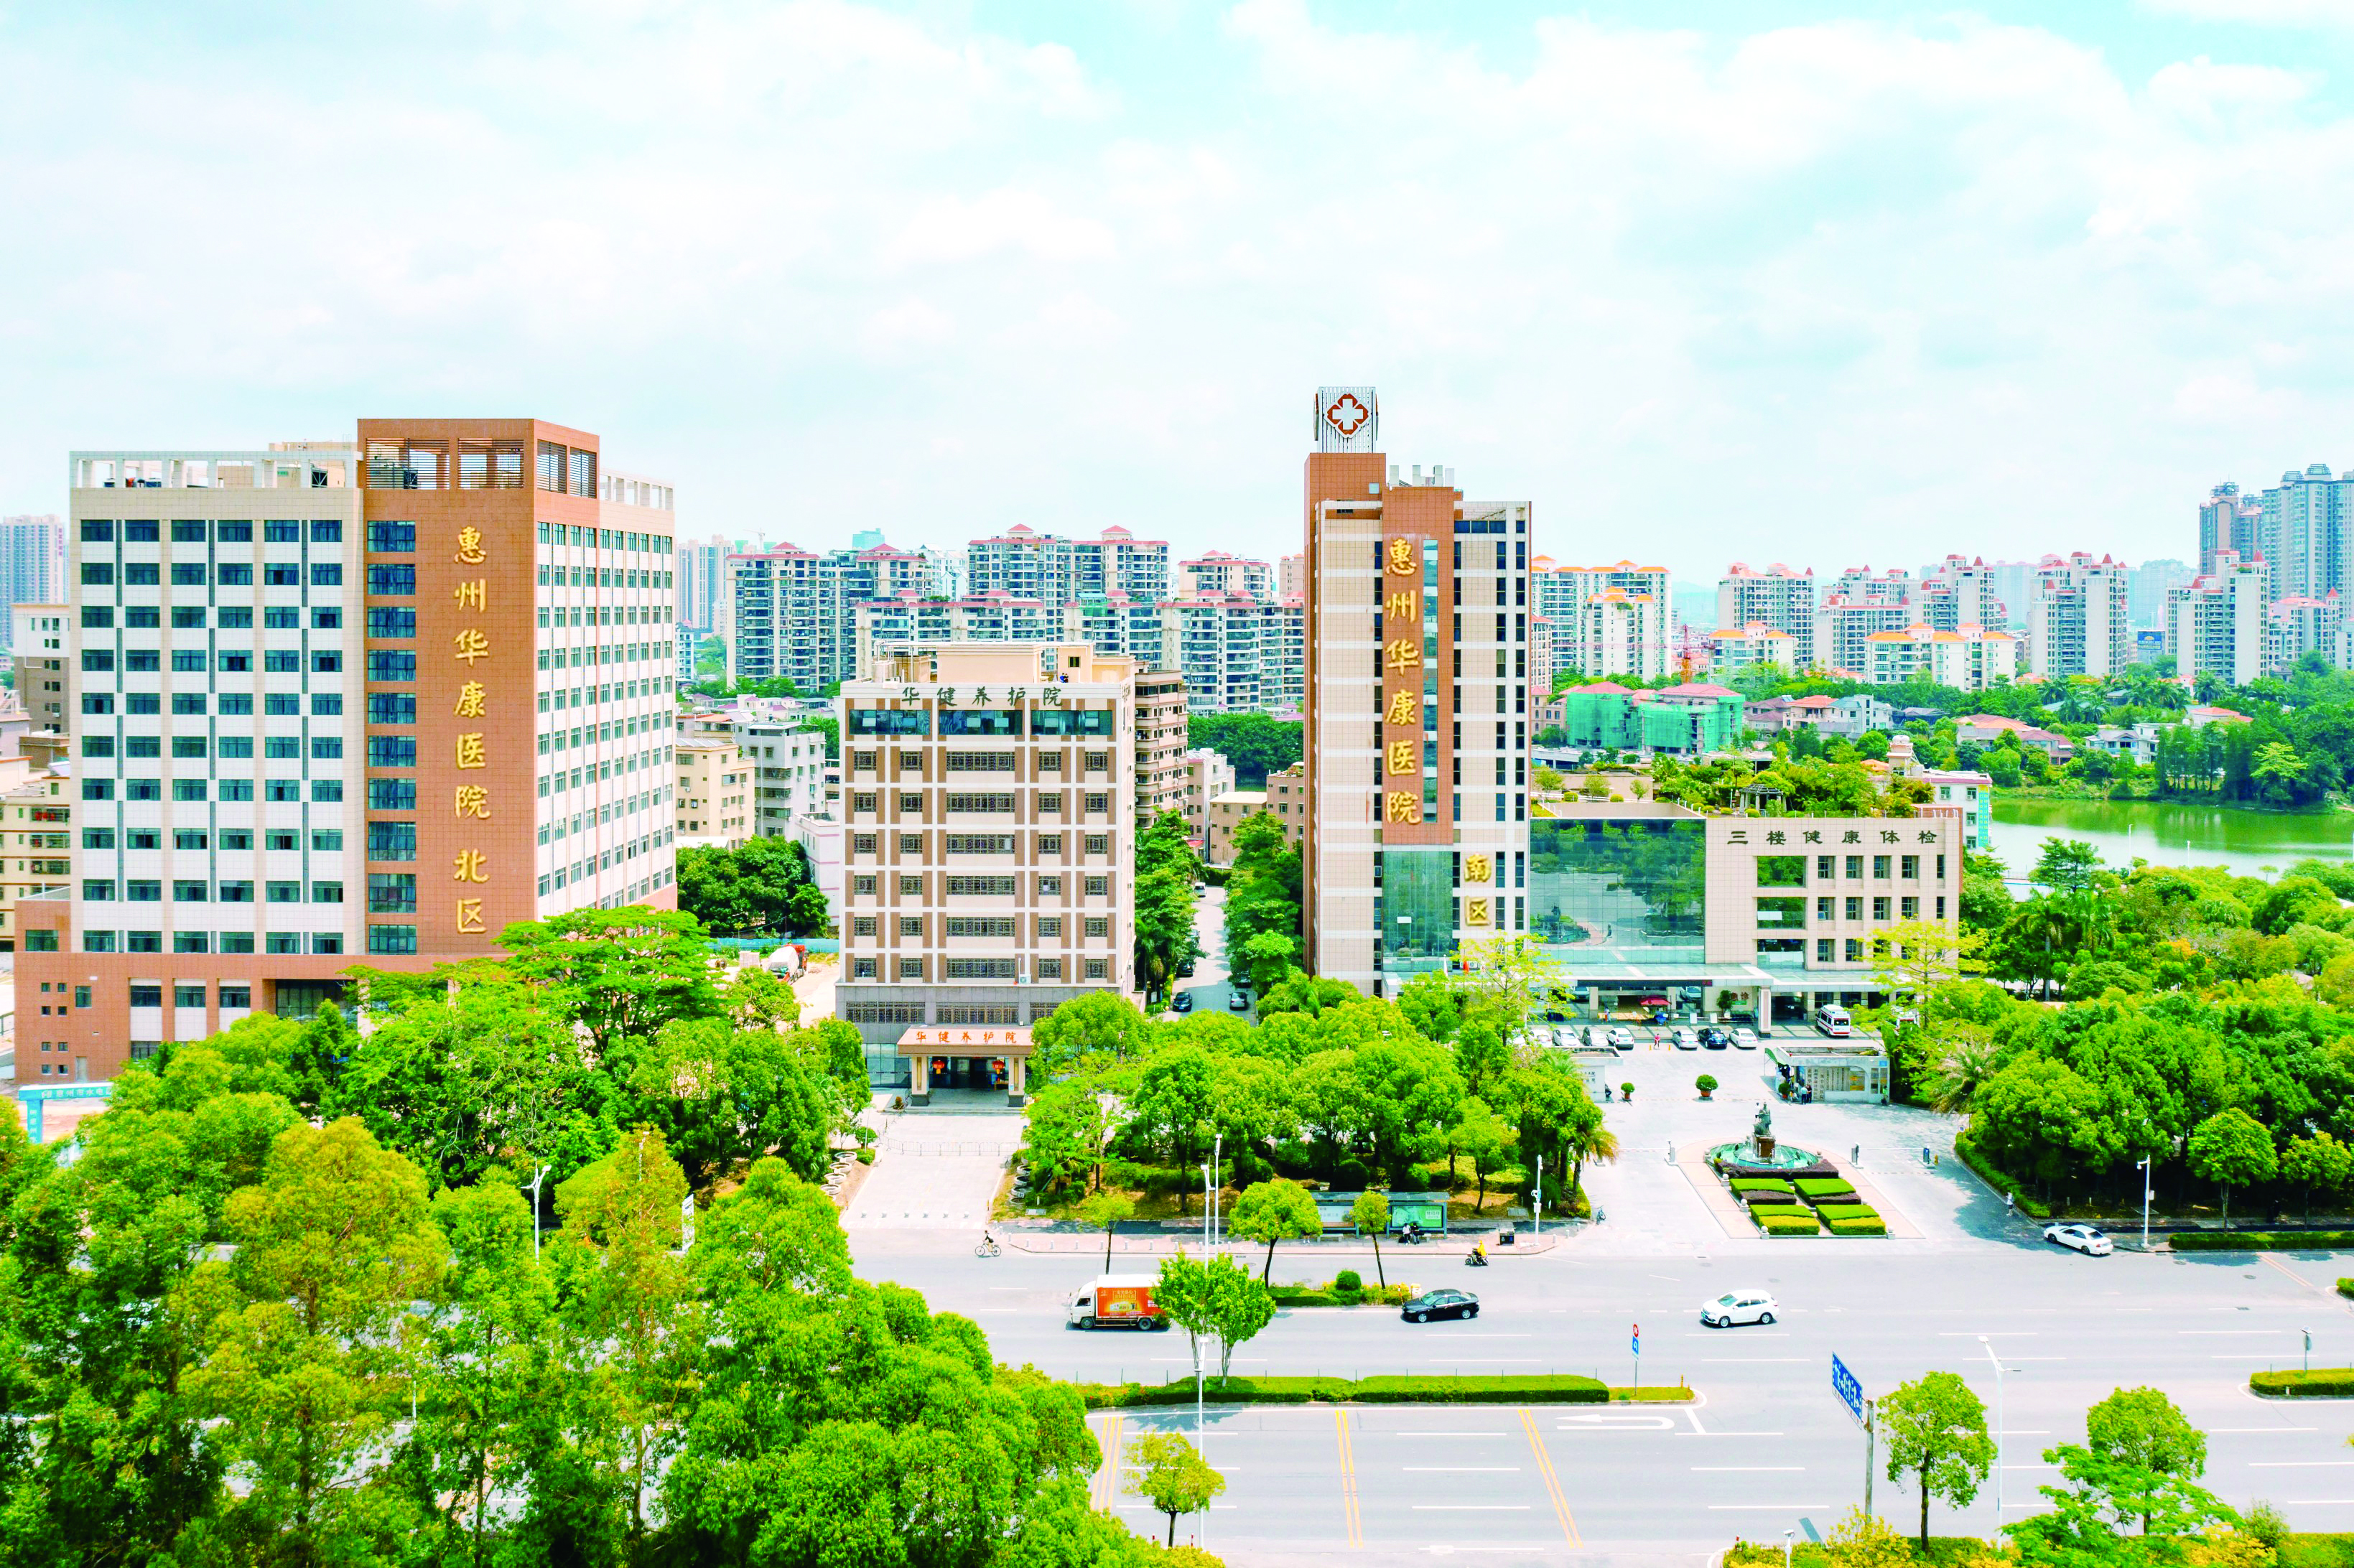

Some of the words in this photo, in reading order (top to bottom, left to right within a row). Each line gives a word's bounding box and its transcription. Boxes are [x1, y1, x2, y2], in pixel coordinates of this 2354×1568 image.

[902, 686, 1063, 706] 华健养护院
[1384, 538, 1421, 825] 惠州华康医院
[453, 526, 491, 934] 惠州华康医院北区
[1727, 830, 1937, 845] 三楼健康体检
[1464, 854, 1492, 926] 南区
[916, 1031, 1017, 1043] 华健养护院
